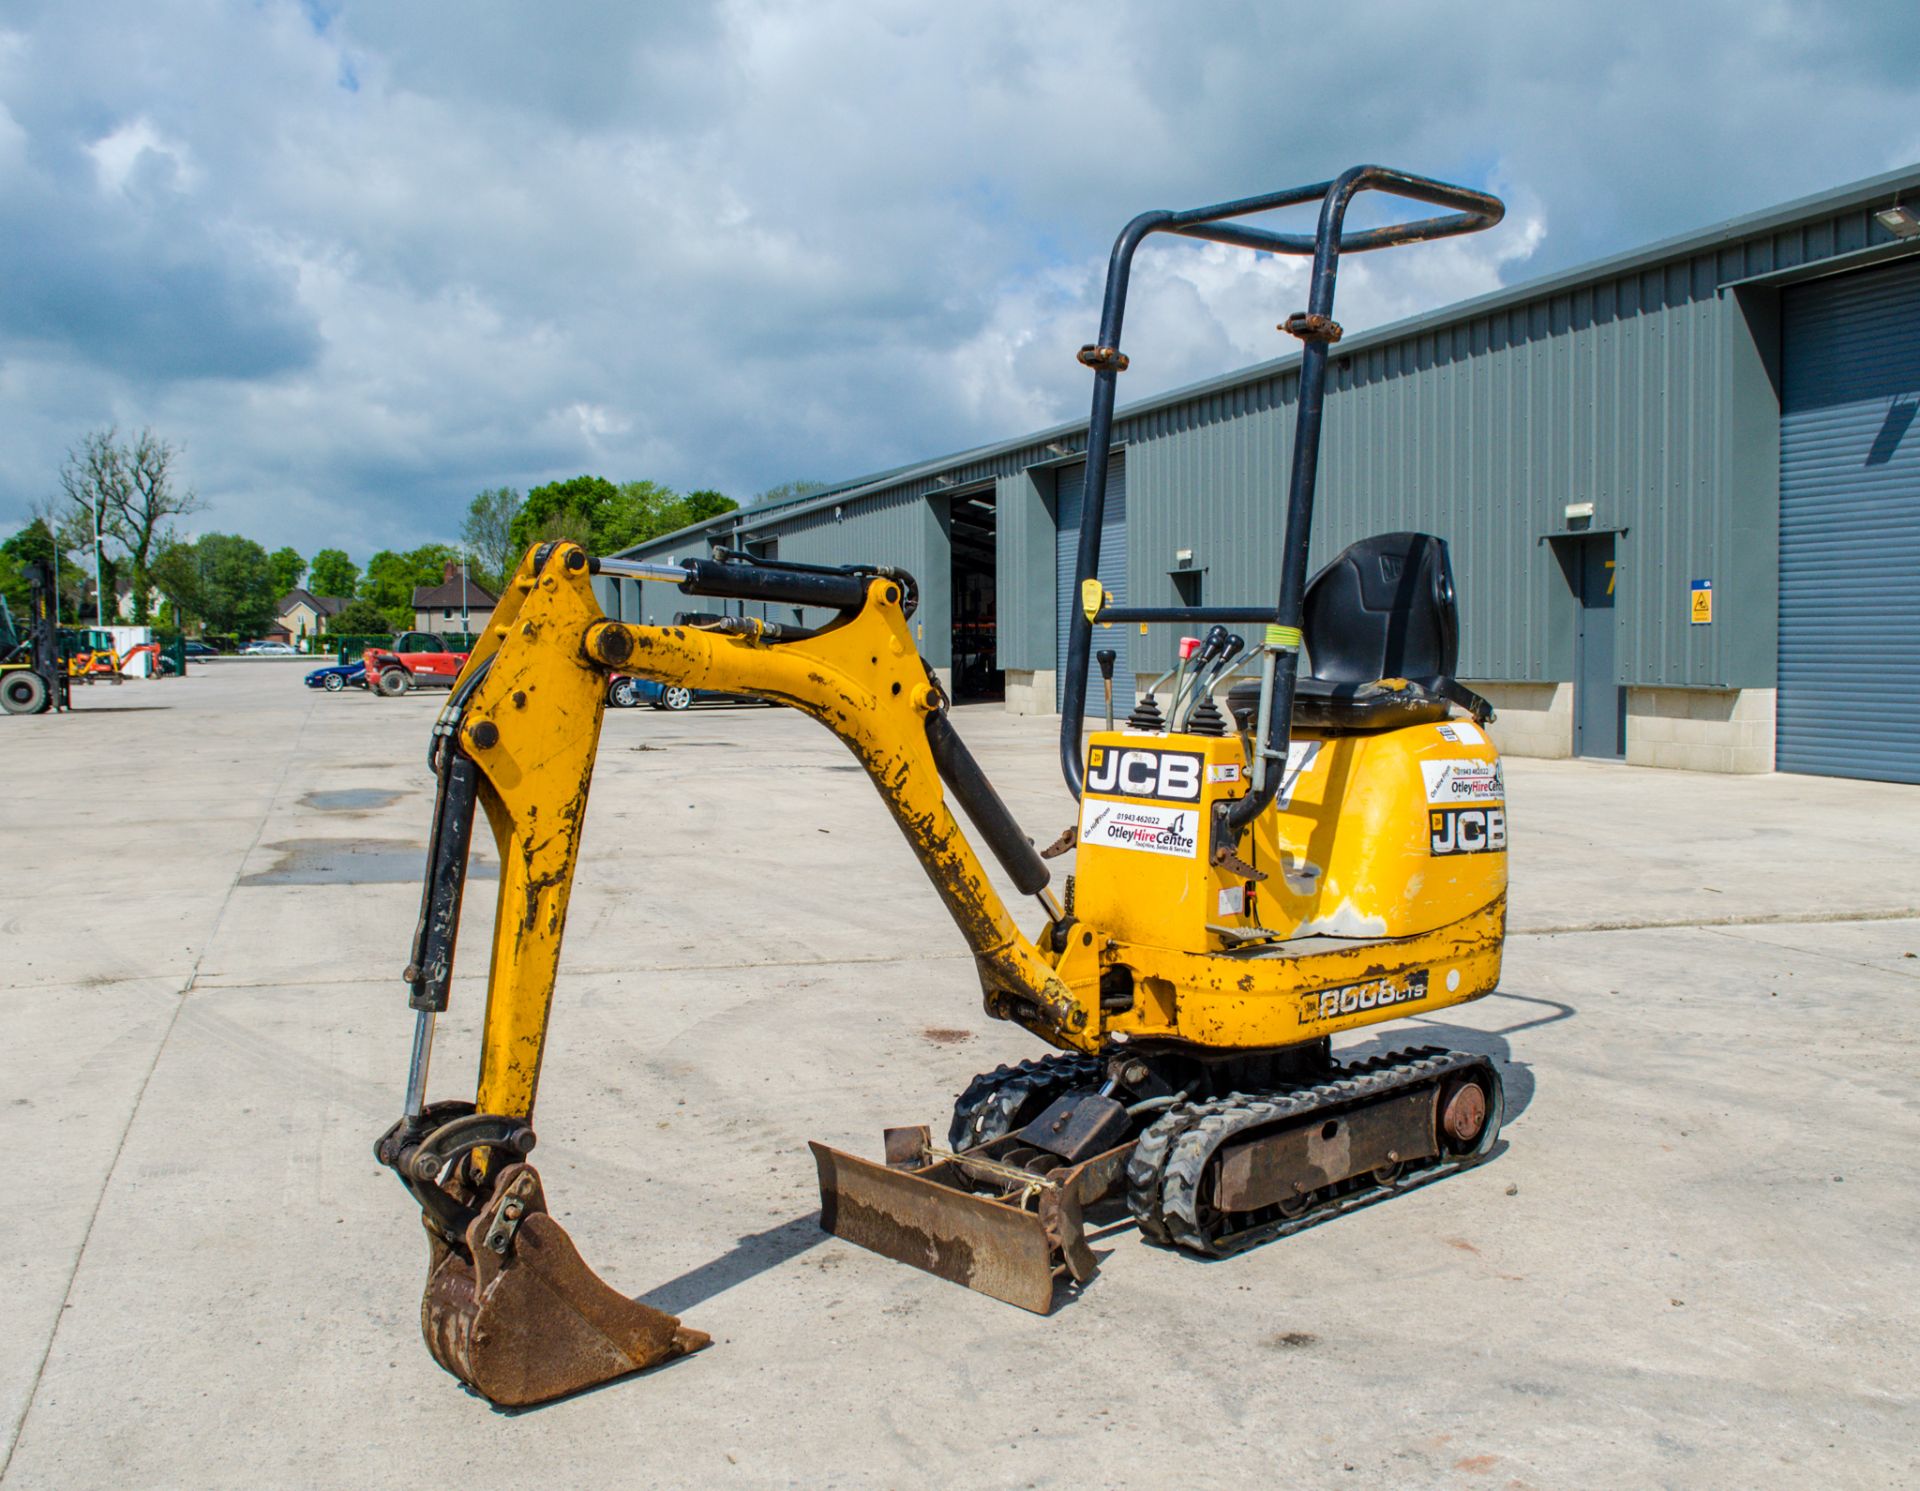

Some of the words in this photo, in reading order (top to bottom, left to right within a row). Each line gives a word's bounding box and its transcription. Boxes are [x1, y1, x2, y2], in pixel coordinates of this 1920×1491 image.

[1088, 749, 1200, 799] JCB
[1117, 813, 1135, 822] 01943
[1136, 815, 1160, 825] 462022
[1432, 811, 1505, 852] JCB
[1107, 825, 1193, 848] OtleyHireCentre
